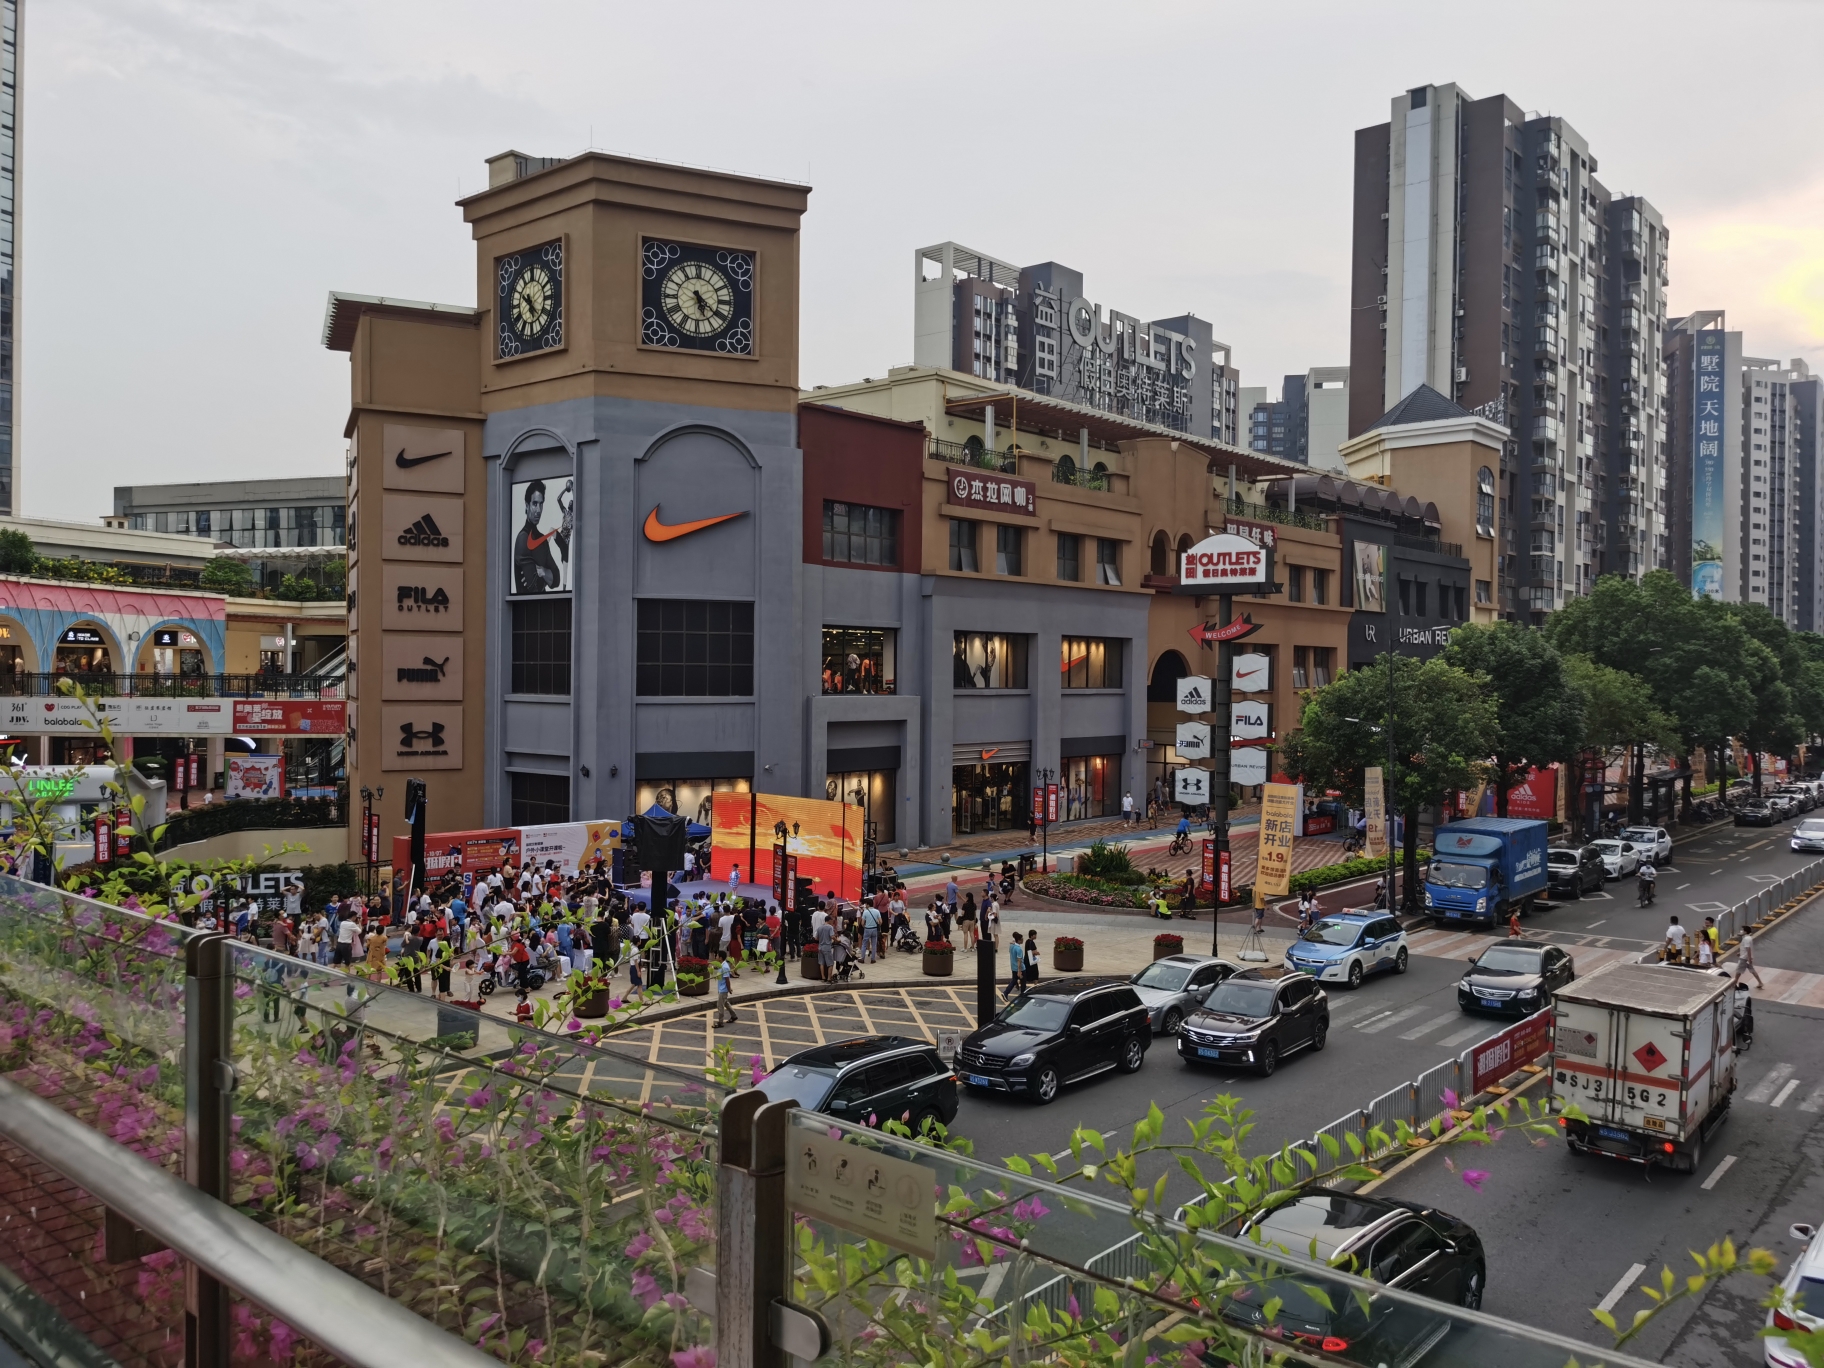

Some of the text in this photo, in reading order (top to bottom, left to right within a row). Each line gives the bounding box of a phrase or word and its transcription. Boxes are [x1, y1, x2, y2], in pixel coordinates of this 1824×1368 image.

[1033, 281, 1058, 380] 益田
[1067, 297, 1196, 380] OUTLETS
[1701, 355, 1719, 392] 墅院
[1079, 353, 1190, 417] 假日奥特莱斯
[1700, 400, 1719, 457] 天地阔
[970, 480, 1026, 506] 杰拉网咖
[397, 533, 449, 547] adidas
[1185, 553, 1195, 578] 益田
[1198, 551, 1261, 567] OUTLETS
[397, 586, 449, 605] FILA
[398, 605, 449, 613] OUTLET
[1205, 624, 1242, 639] WELCOME
[1399, 628, 1432, 645] URBAN
[397, 668, 439, 682] PUMA
[1181, 697, 1206, 705] adidas
[44, 717, 82, 726] balabala
[1235, 715, 1263, 726] FILA
[28, 779, 74, 791] LINLEE
[1511, 793, 1537, 801] adidas
[1266, 810, 1293, 819] balabala
[1265, 819, 1292, 833] 新店
[1264, 833, 1291, 848] 开业
[1267, 851, 1284, 863] 1.9
